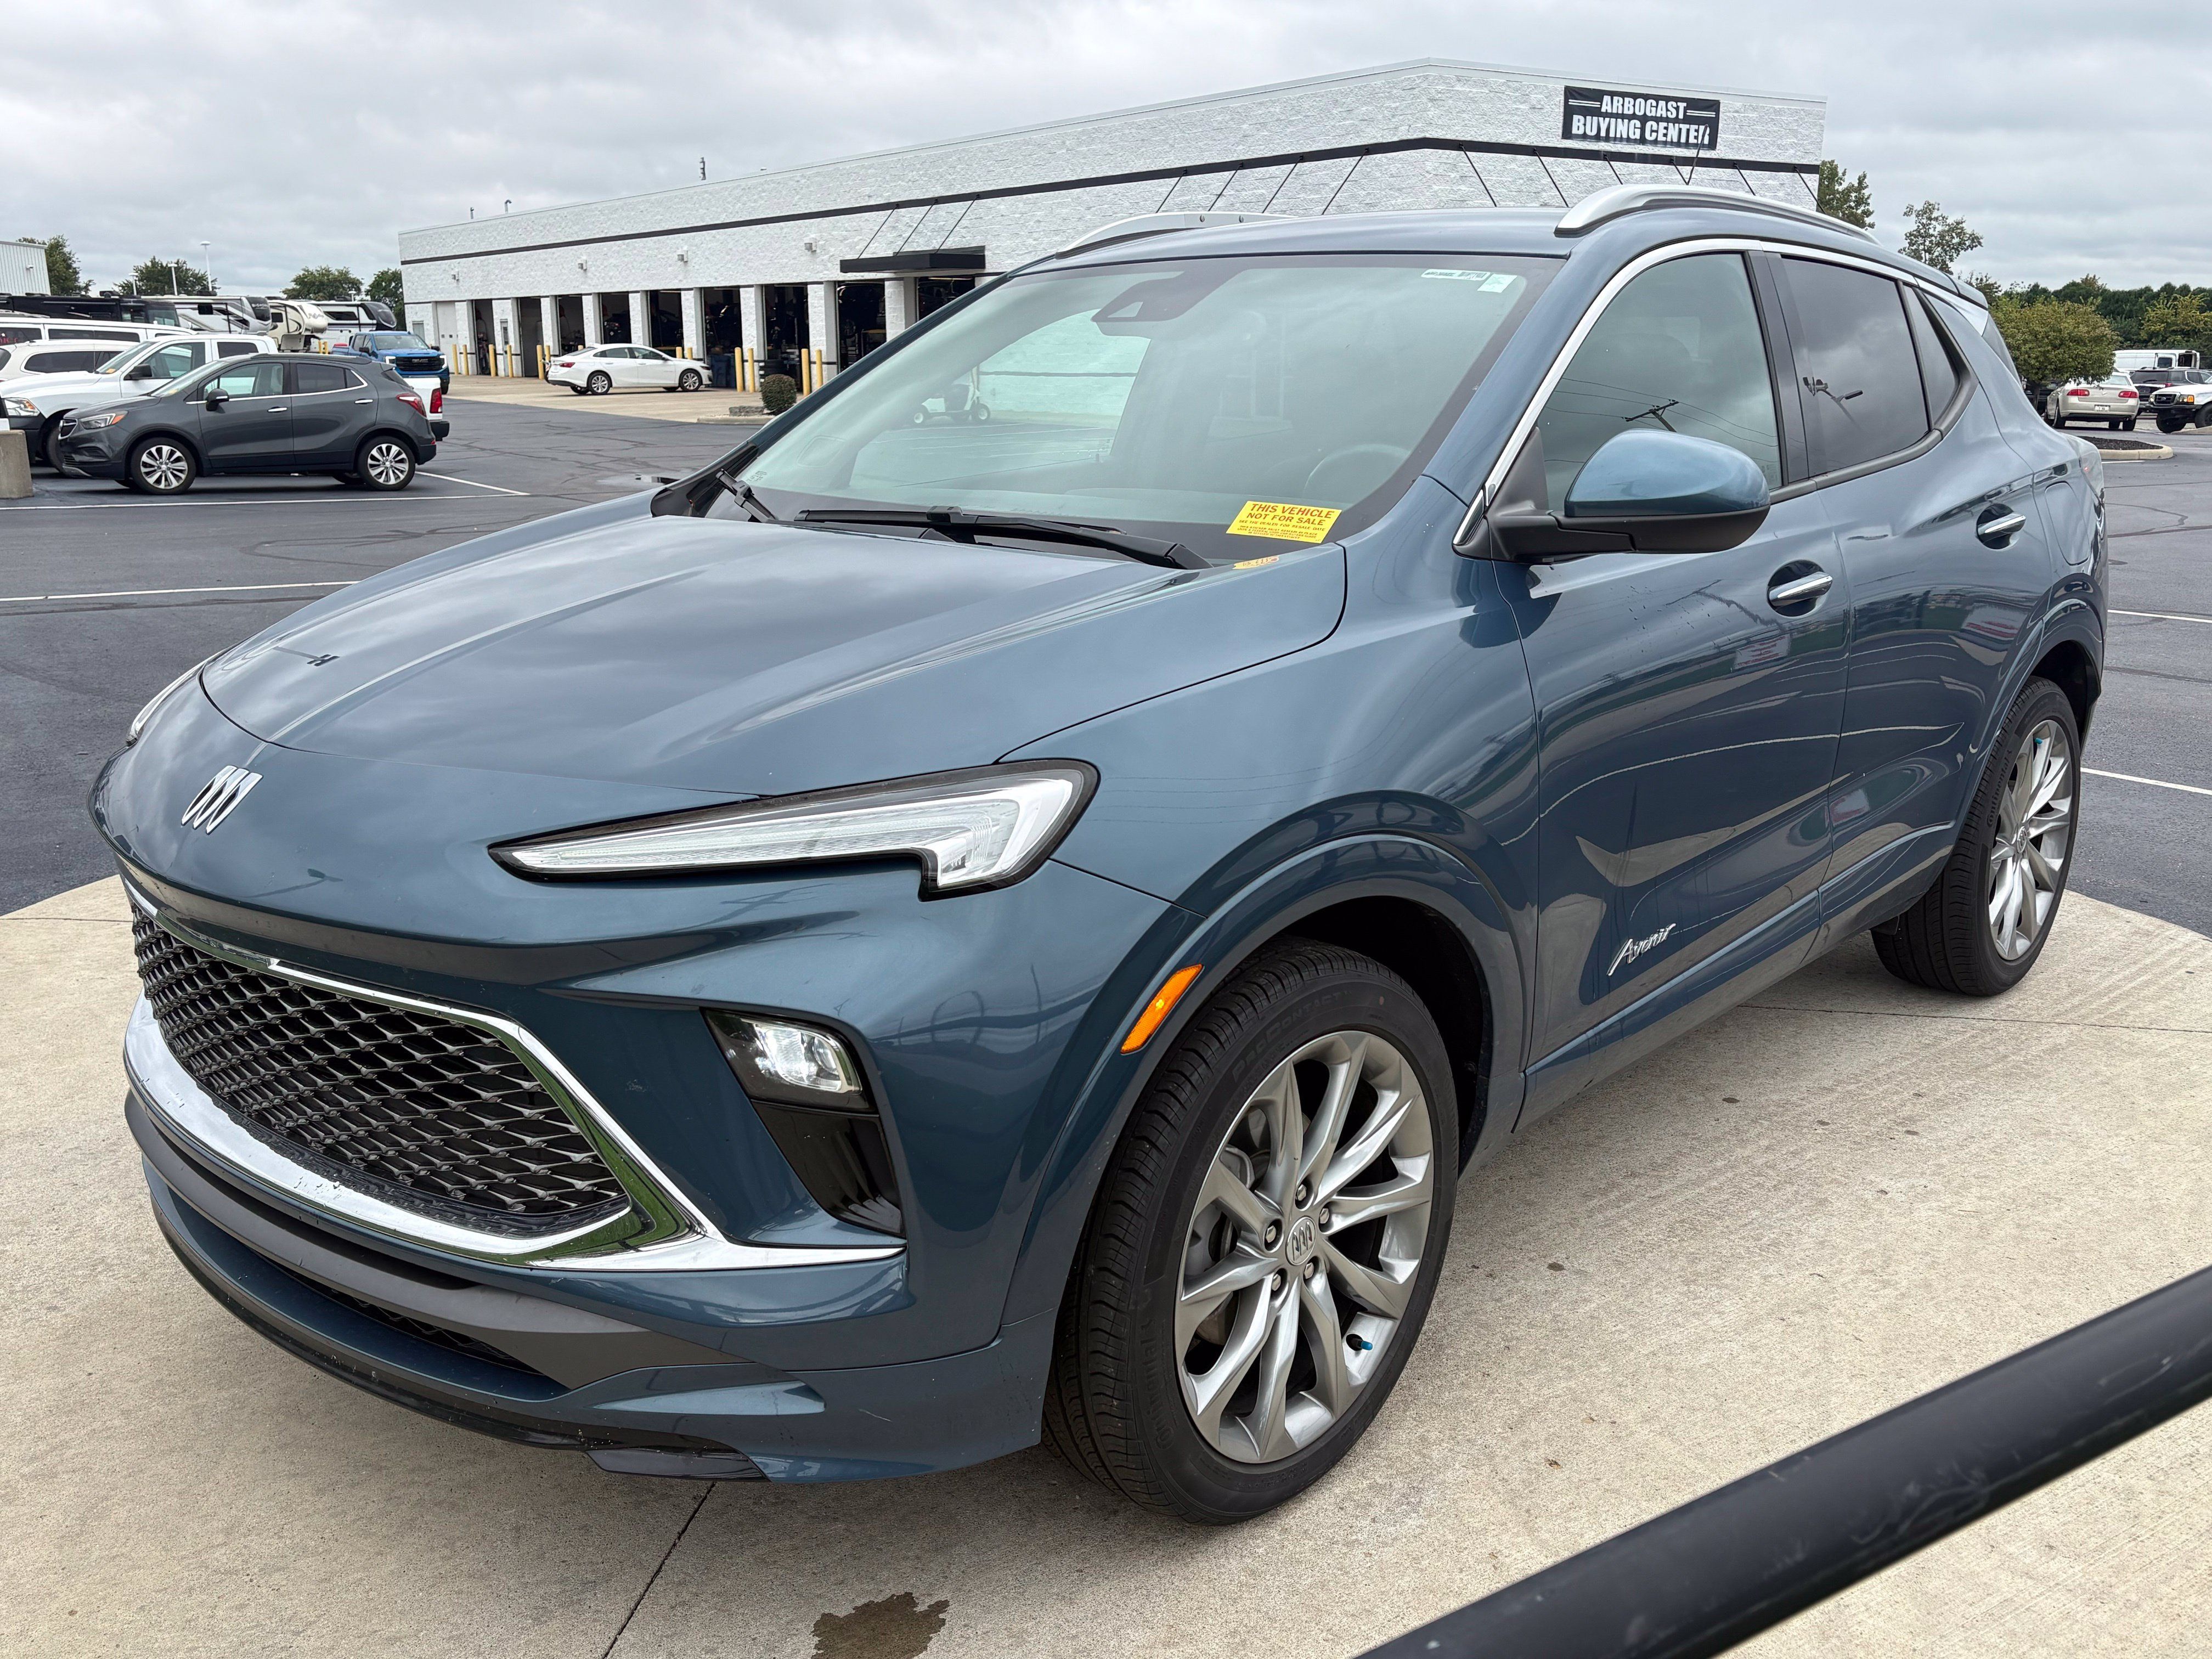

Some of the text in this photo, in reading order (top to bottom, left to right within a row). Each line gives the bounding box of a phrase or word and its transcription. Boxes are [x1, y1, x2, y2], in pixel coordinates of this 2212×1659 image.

[1600, 94, 1687, 119] ARBOGAST
[1571, 114, 1711, 145] BUYING CENTER
[1250, 503, 1335, 519] THIS VEHICLE
[1296, 517, 1326, 526] SALE
[1606, 923, 1677, 977] Avenir
